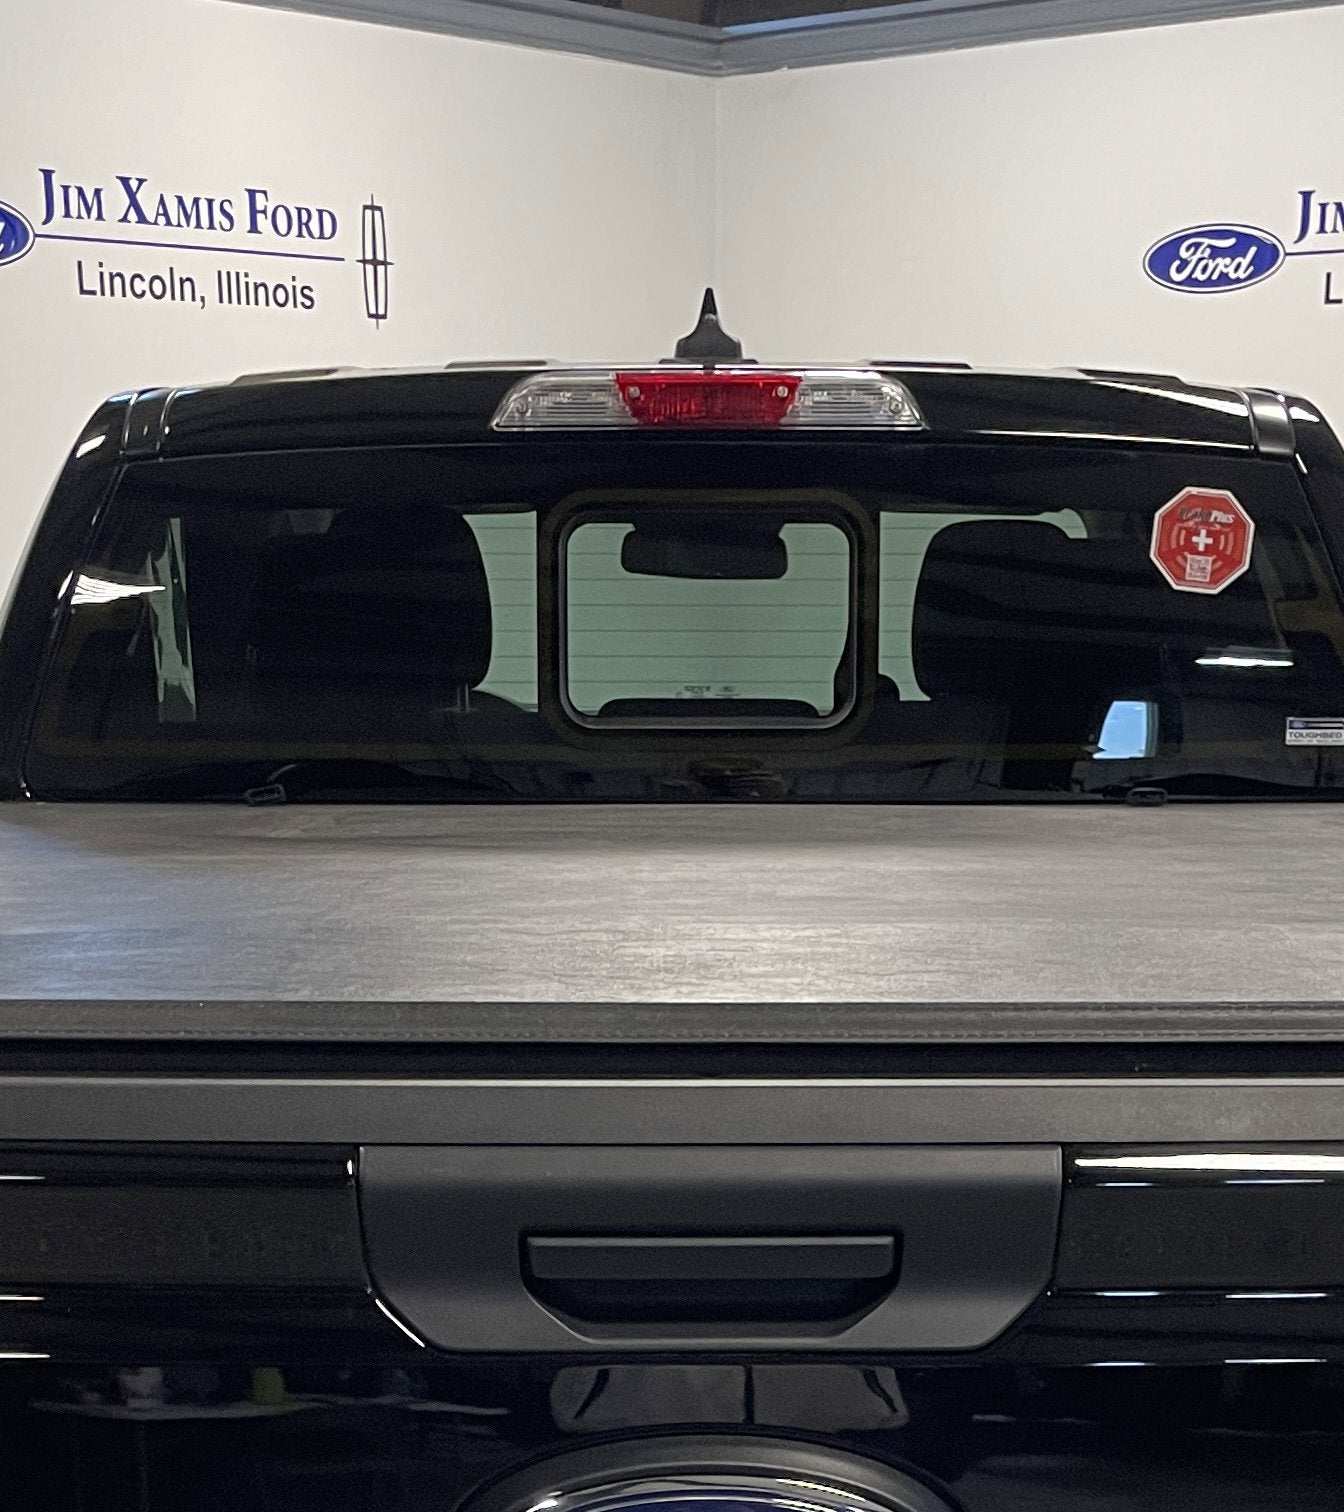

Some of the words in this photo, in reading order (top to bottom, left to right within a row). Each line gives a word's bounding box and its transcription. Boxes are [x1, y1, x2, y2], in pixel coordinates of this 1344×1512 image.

[37, 168, 103, 226] JIM
[116, 176, 234, 232] XAMIS
[244, 188, 338, 240] FORD
[76, 260, 208, 309] Lincoln,
[217, 269, 315, 310] Illinois
[1168, 238, 1255, 282] Ford
